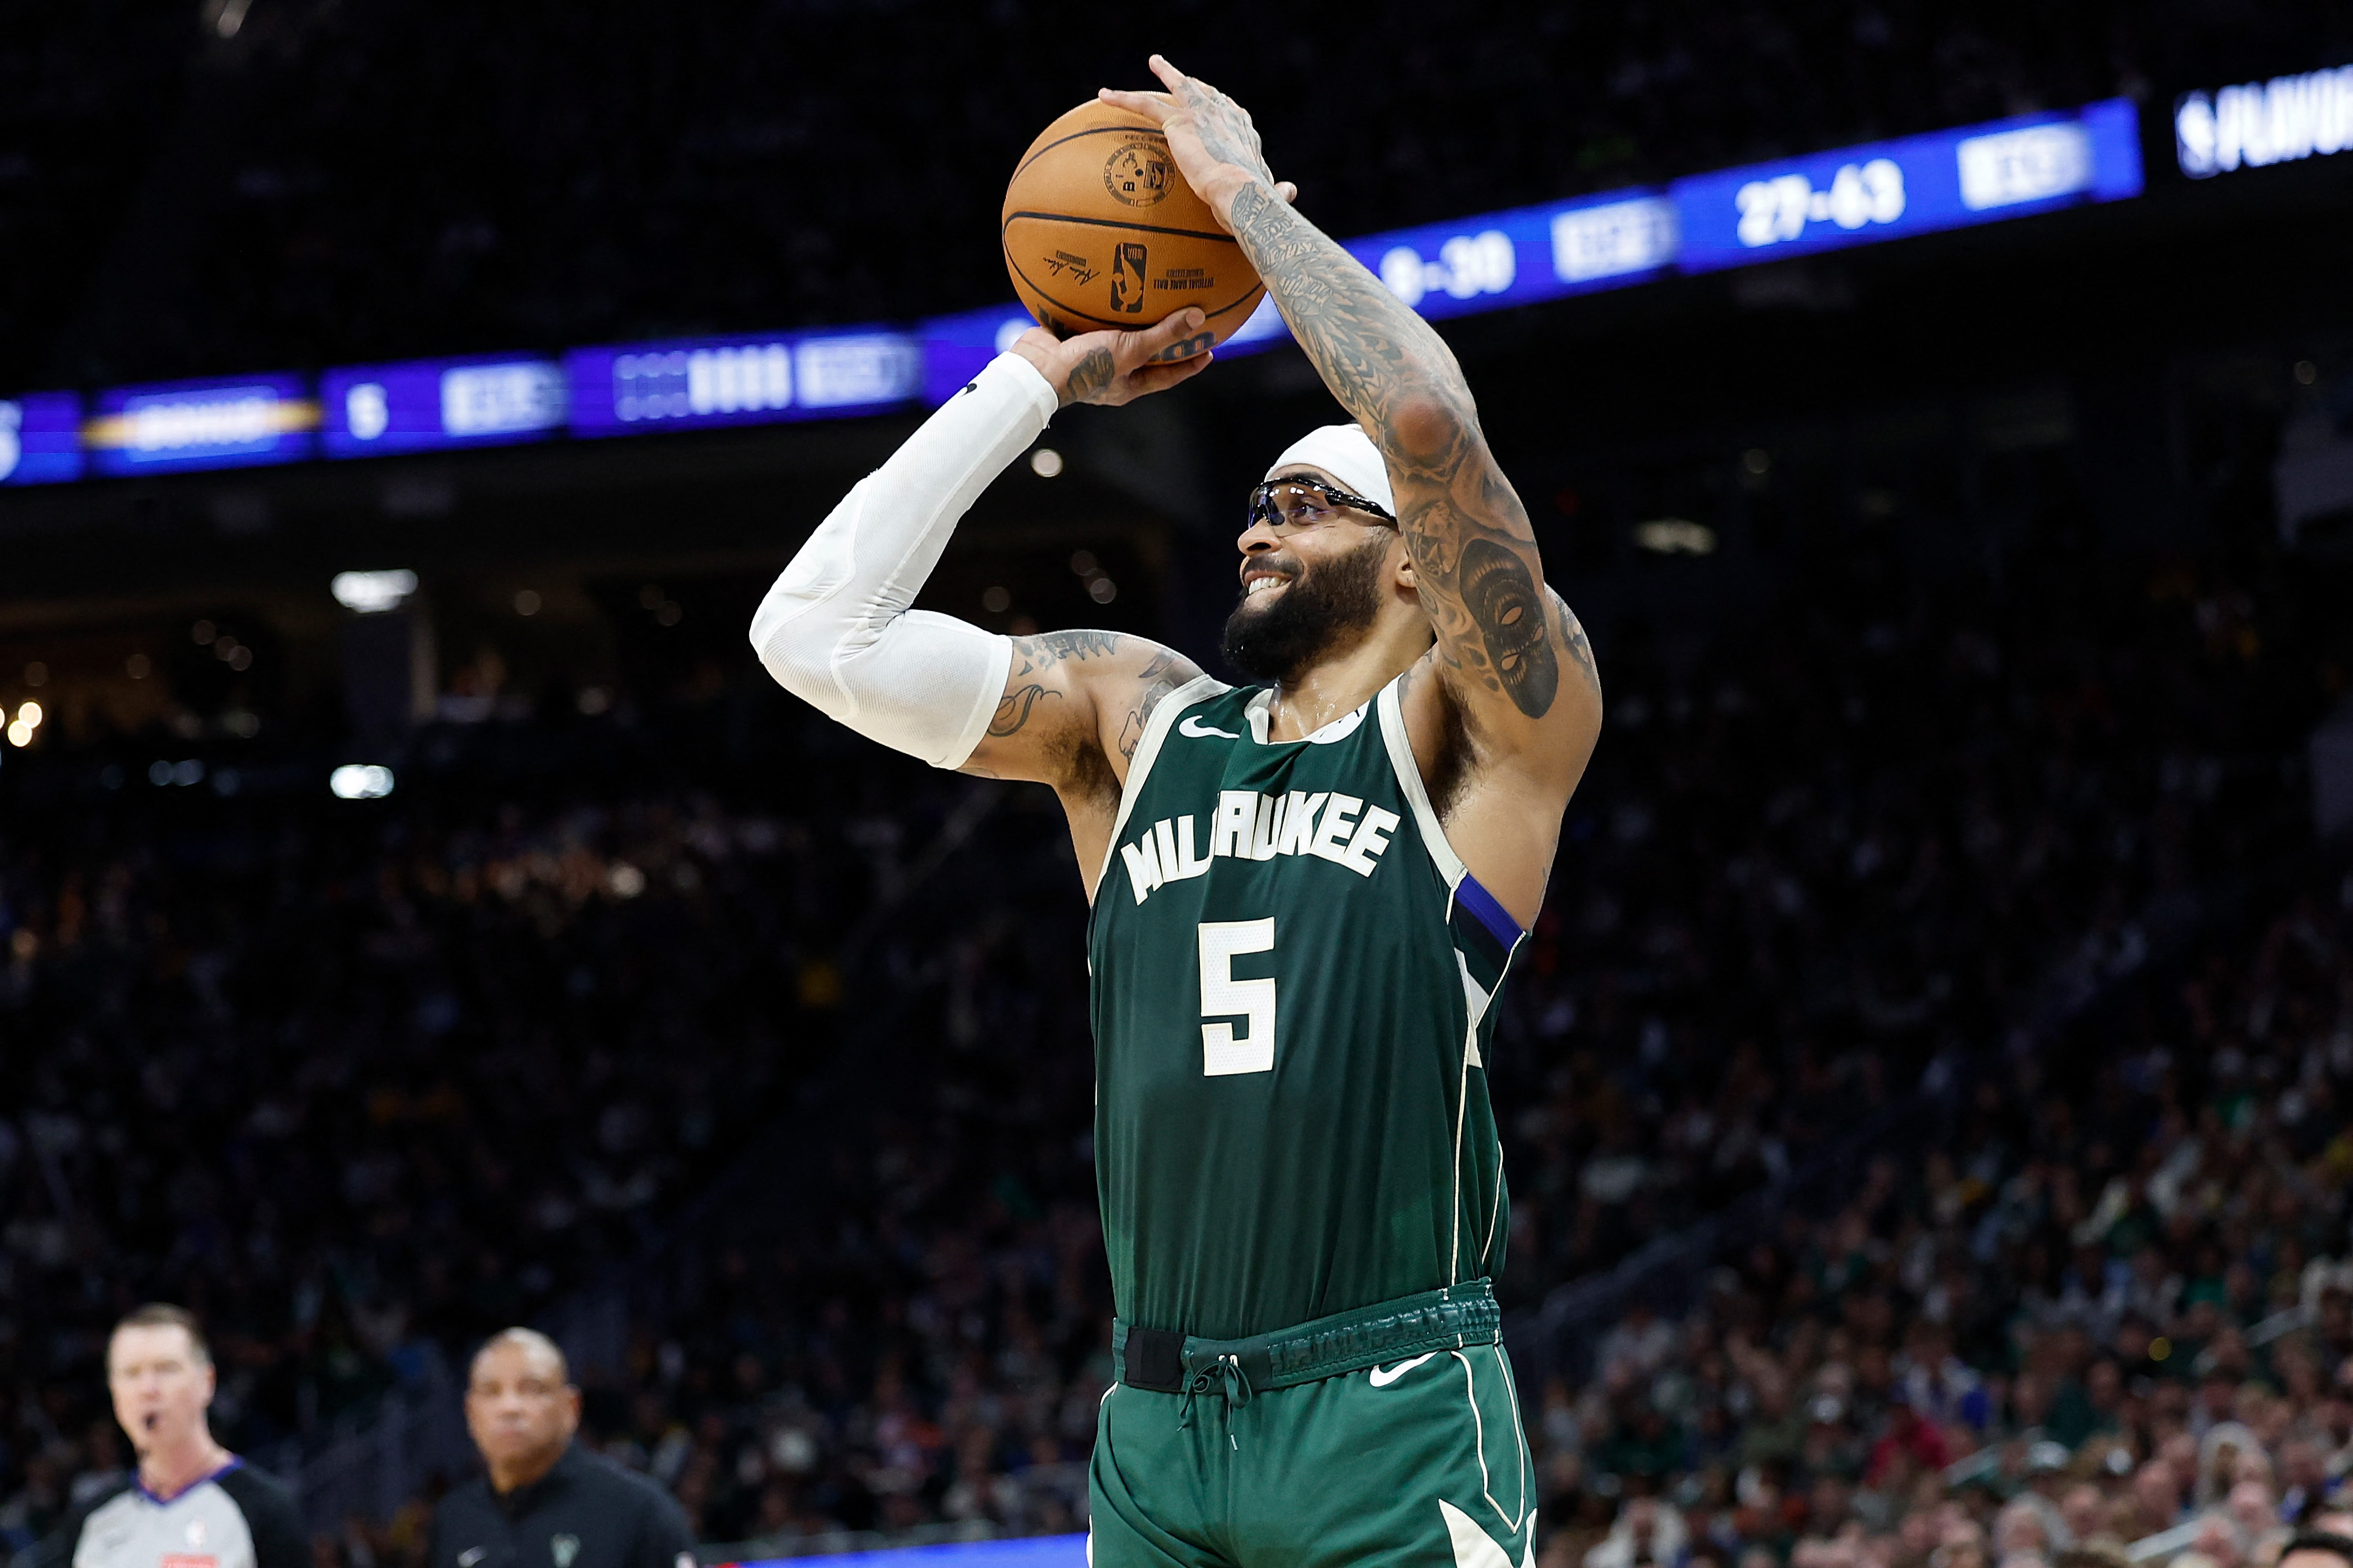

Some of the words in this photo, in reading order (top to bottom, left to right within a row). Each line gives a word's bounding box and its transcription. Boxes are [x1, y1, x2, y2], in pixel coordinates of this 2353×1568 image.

[1127, 248, 1143, 260] NBA
[1154, 279, 1169, 289] BALL
[1121, 790, 1401, 905] MILAUKEE
[1198, 916, 1276, 1076] 5
